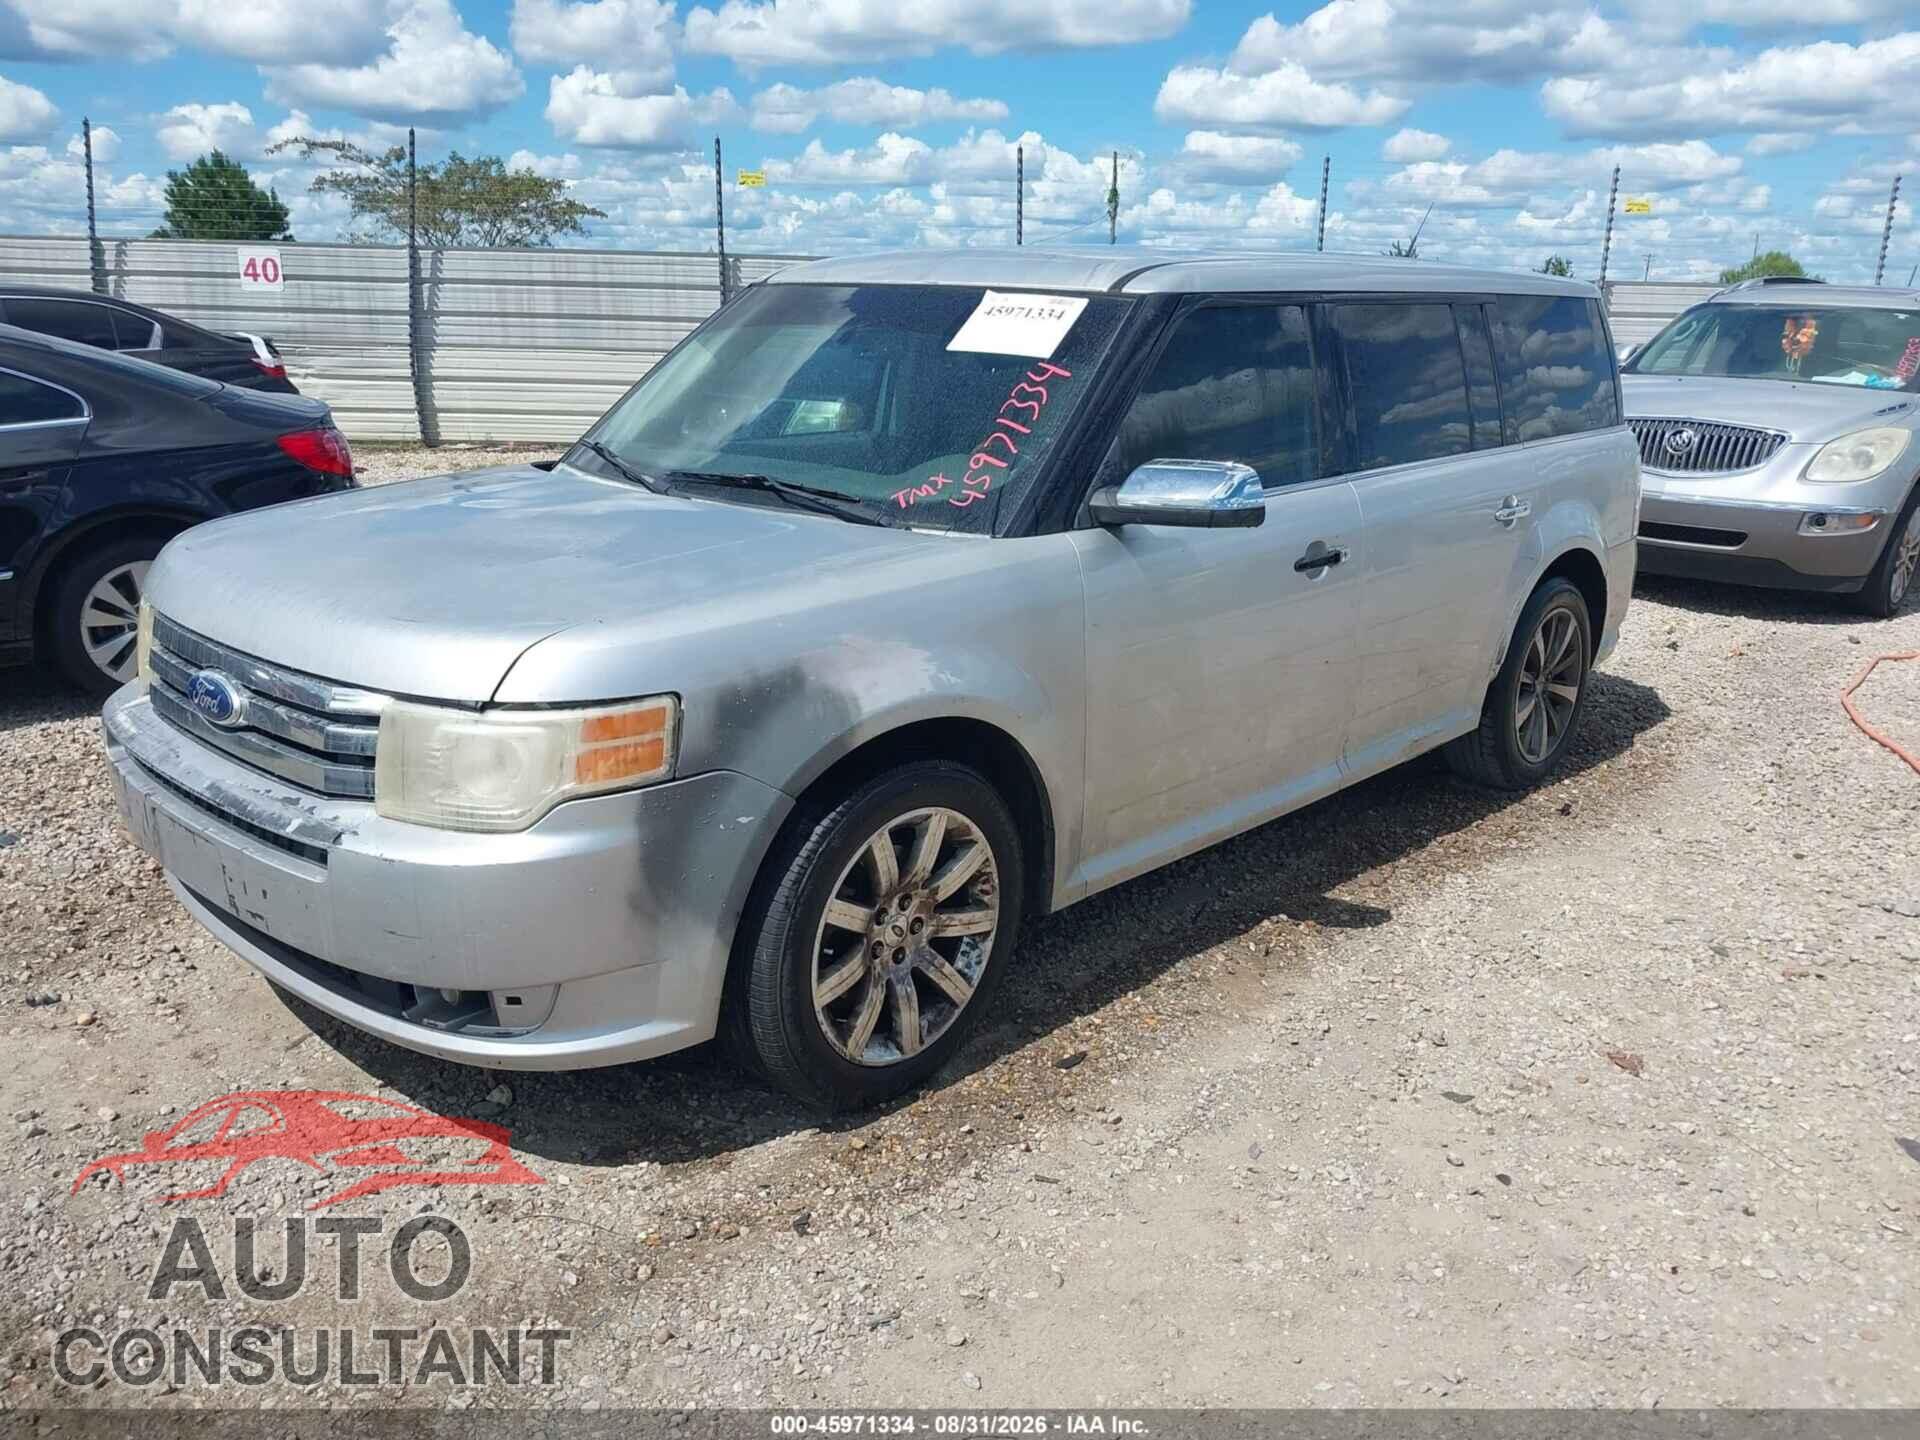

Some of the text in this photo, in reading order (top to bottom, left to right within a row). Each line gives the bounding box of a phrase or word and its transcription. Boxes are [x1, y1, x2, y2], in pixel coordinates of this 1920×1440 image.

[243, 257, 279, 283] 40
[984, 305, 1066, 320] 45971334
[949, 362, 1072, 507] 45971334
[192, 677, 222, 713] Ford
